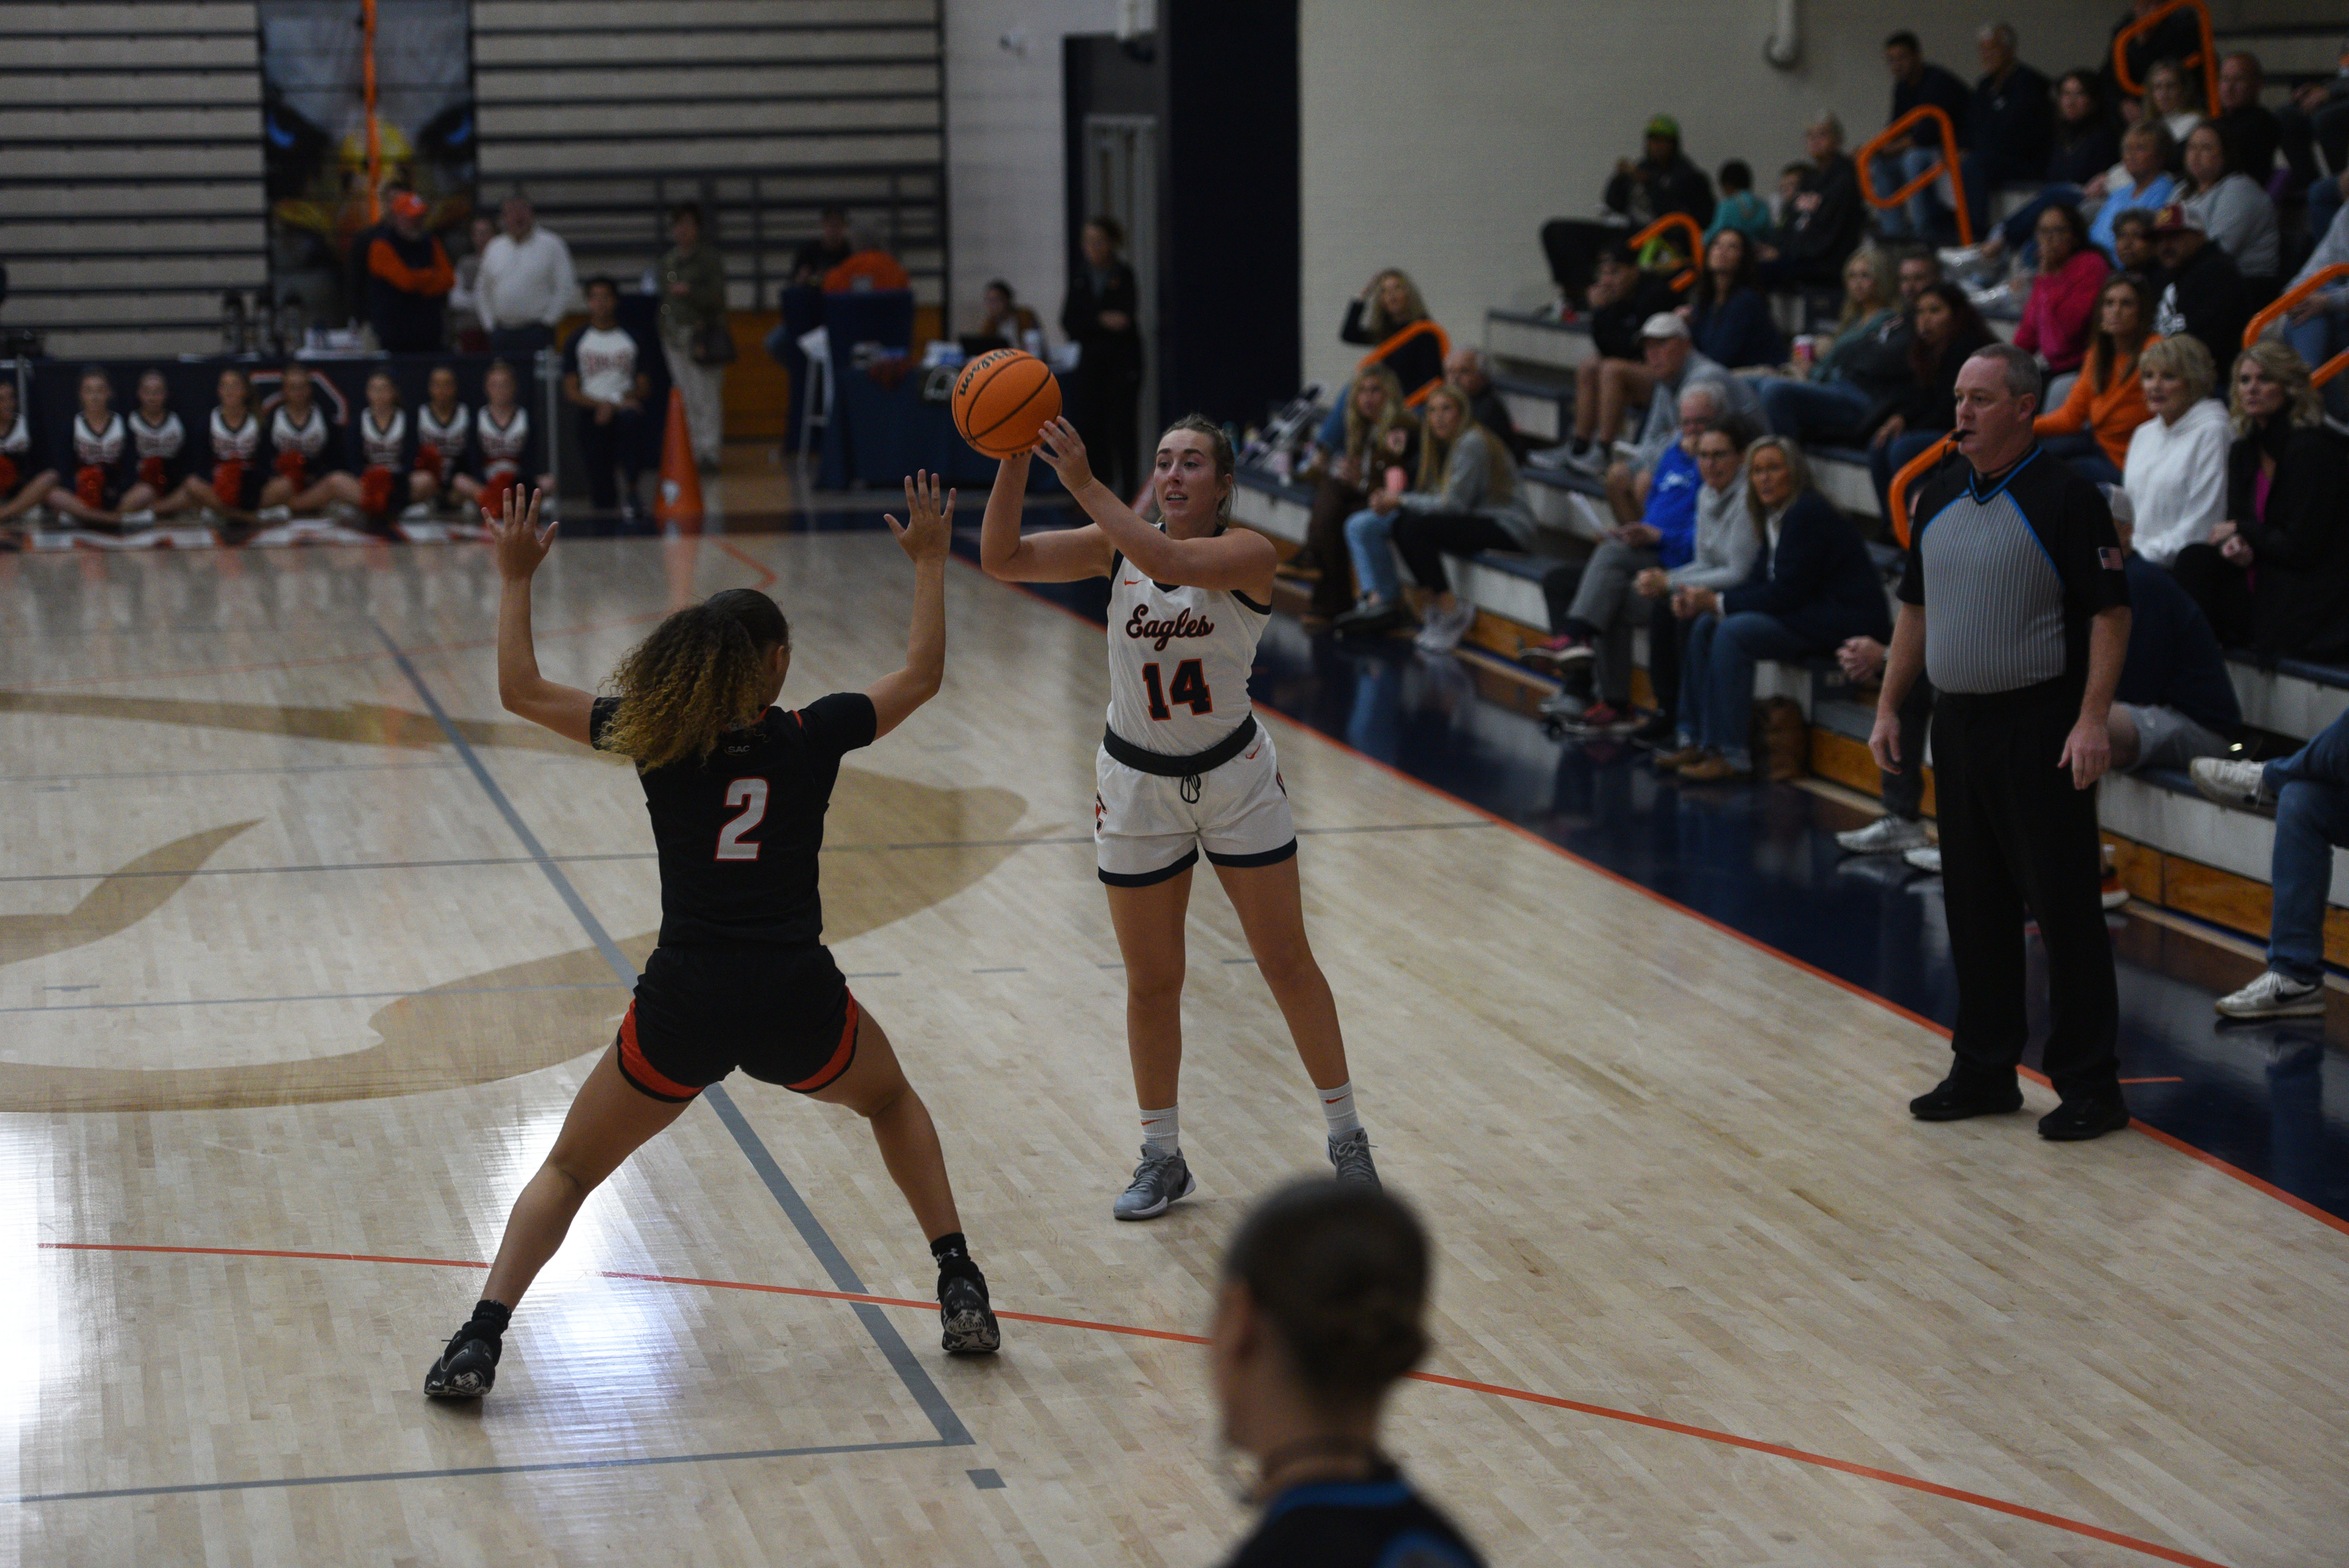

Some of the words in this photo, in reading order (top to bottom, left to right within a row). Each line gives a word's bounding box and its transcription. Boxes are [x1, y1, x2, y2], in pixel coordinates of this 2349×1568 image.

[1126, 604, 1215, 652] Eagles
[1142, 658, 1213, 721] 14
[728, 744, 751, 753] SAC
[714, 776, 770, 861] 2
